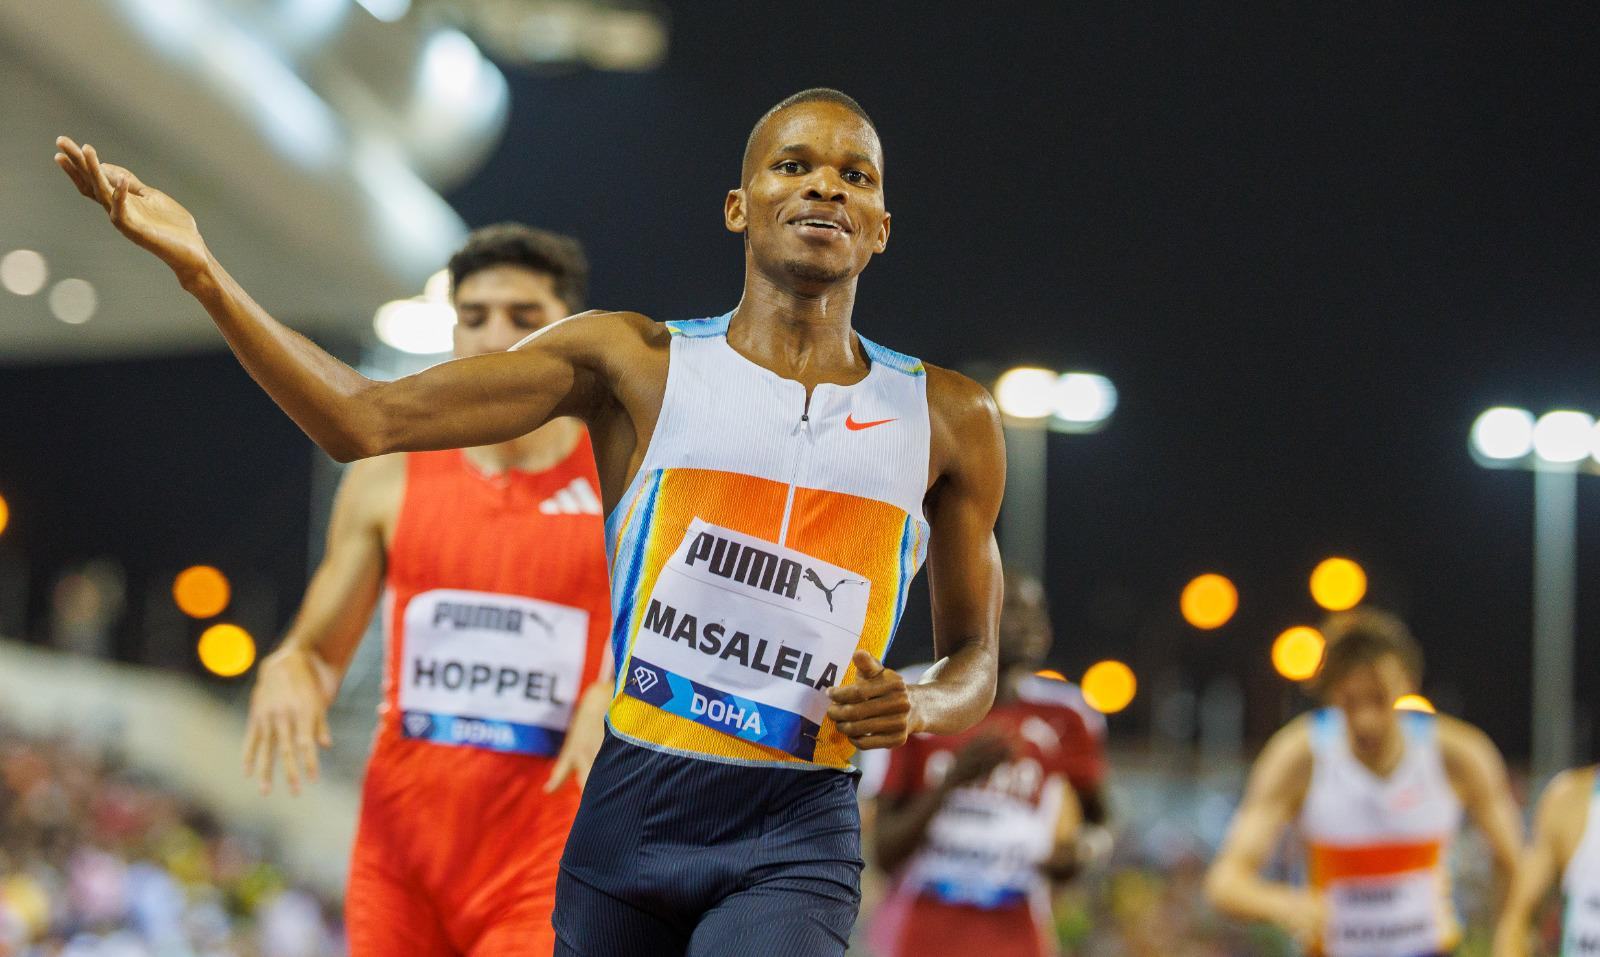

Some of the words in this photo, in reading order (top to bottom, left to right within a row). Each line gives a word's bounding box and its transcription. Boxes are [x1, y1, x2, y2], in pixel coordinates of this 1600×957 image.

[684, 531, 802, 600] PUMA
[643, 598, 838, 692] MASALELA
[413, 658, 566, 706] HOPPEL
[690, 693, 762, 736] DOHA
